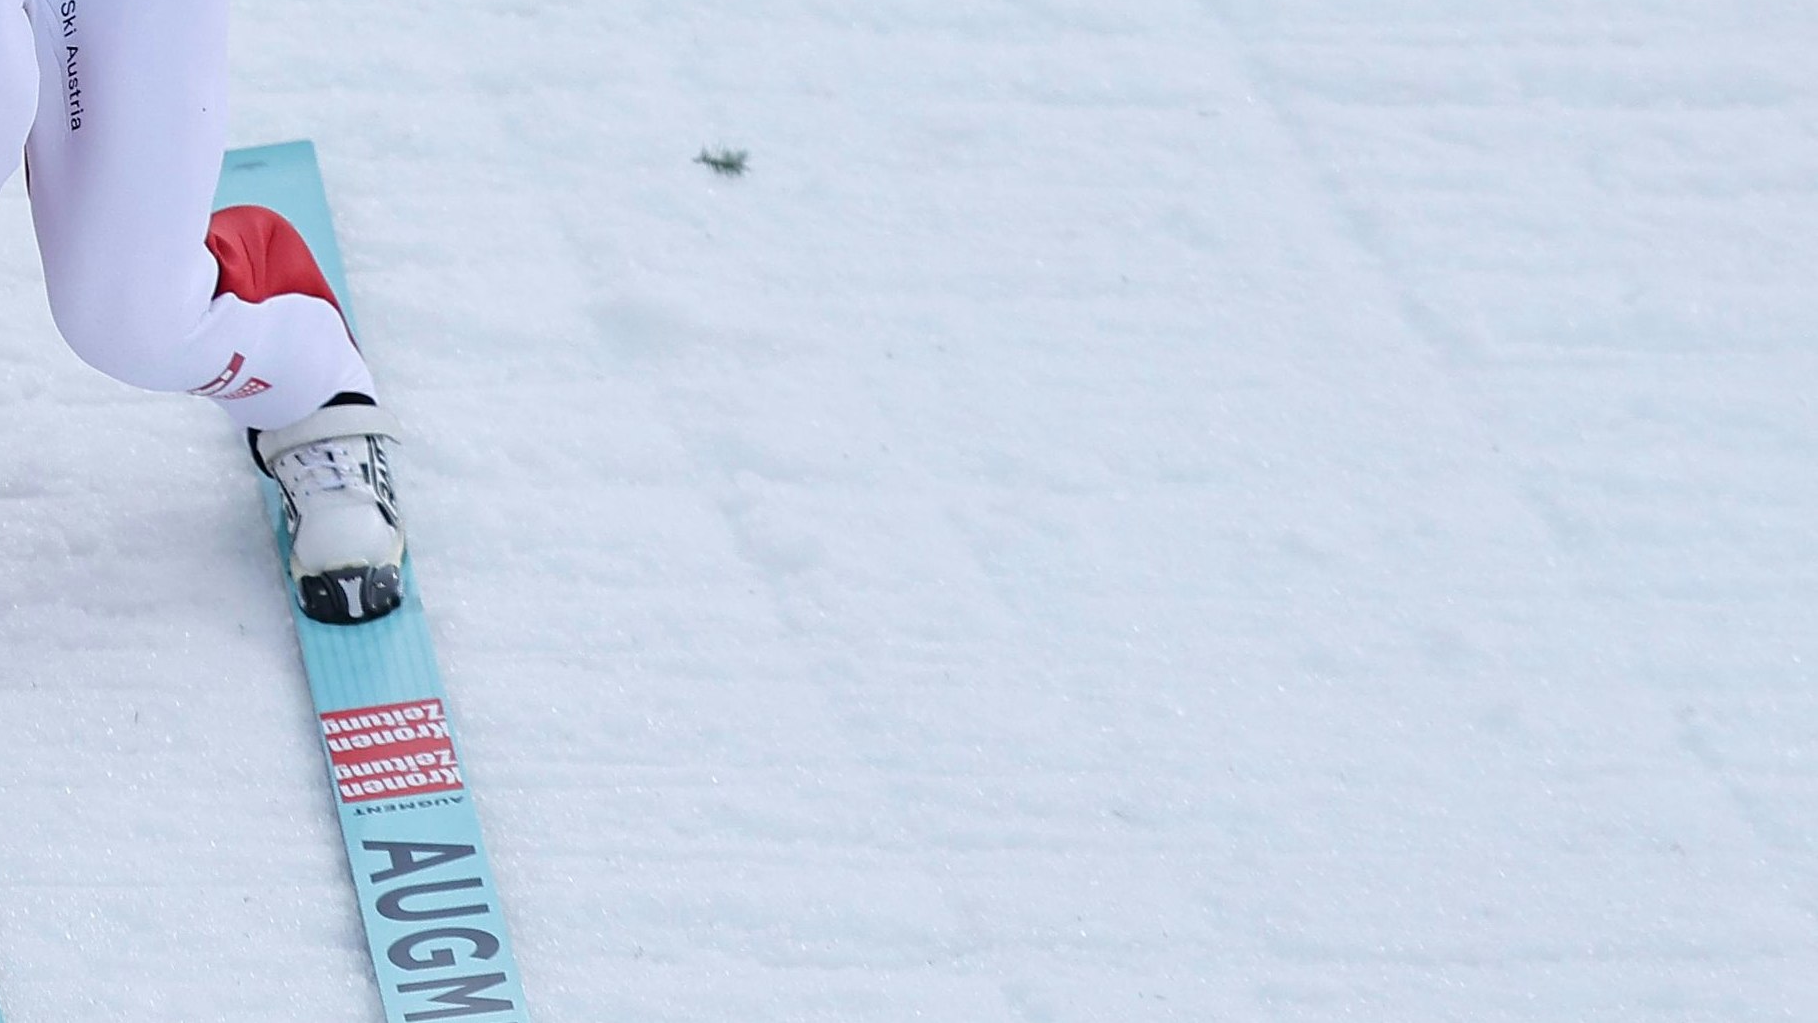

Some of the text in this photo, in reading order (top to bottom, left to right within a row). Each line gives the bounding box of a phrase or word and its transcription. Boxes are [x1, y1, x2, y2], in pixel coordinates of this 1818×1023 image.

[61, 0, 84, 131] Ski Austria
[322, 704, 445, 735] Zeitung
[328, 721, 450, 753] Kronen
[335, 749, 458, 780] Zeitung
[339, 767, 462, 798] Kronen
[353, 795, 465, 817] AUGMENT
